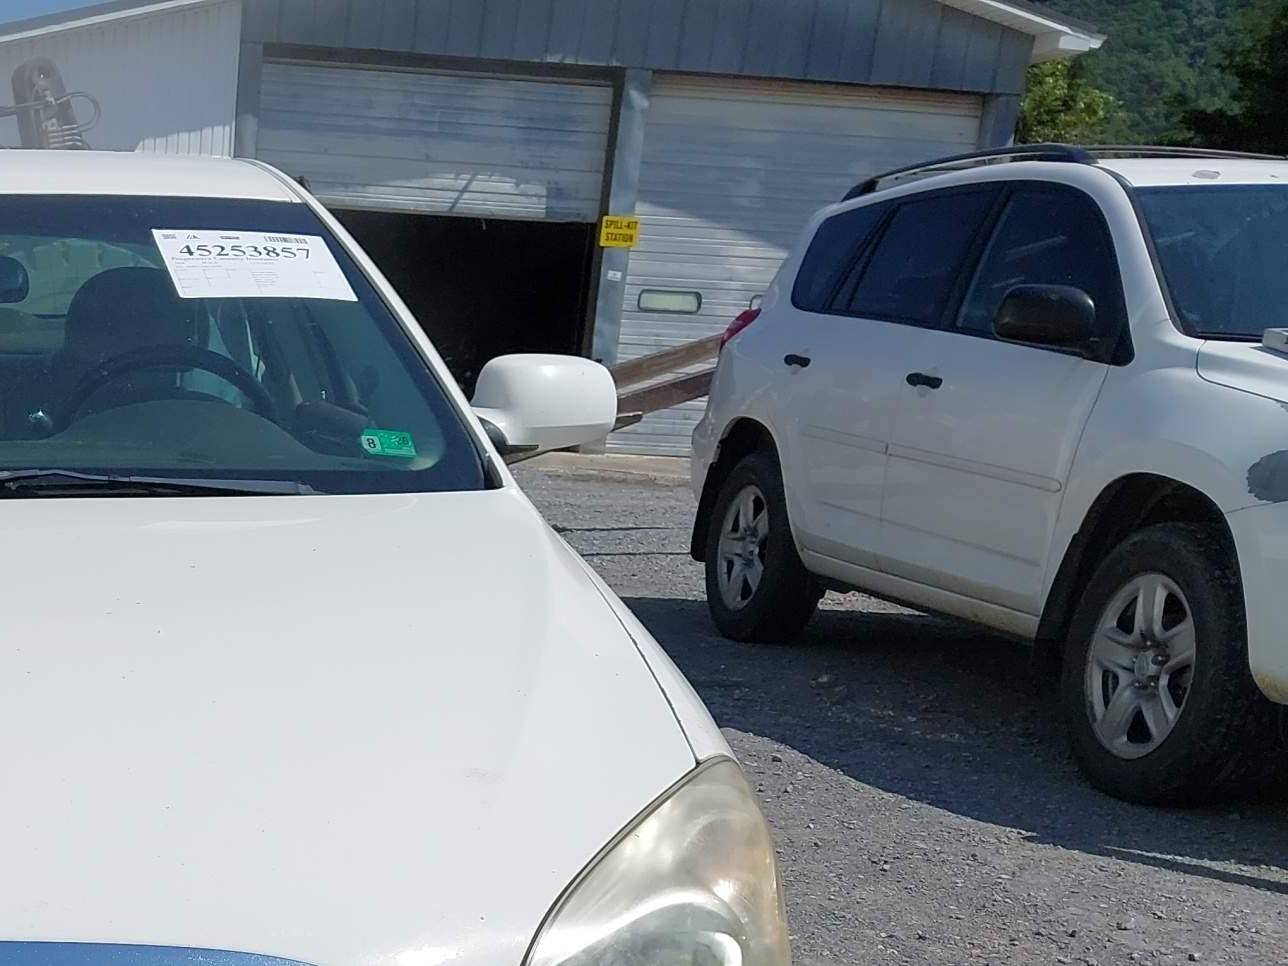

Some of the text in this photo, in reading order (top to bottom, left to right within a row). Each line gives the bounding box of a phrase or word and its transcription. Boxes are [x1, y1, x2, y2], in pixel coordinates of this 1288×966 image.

[605, 232, 634, 243] STATION
[179, 244, 310, 259] 45253857
[366, 438, 377, 449] 8
